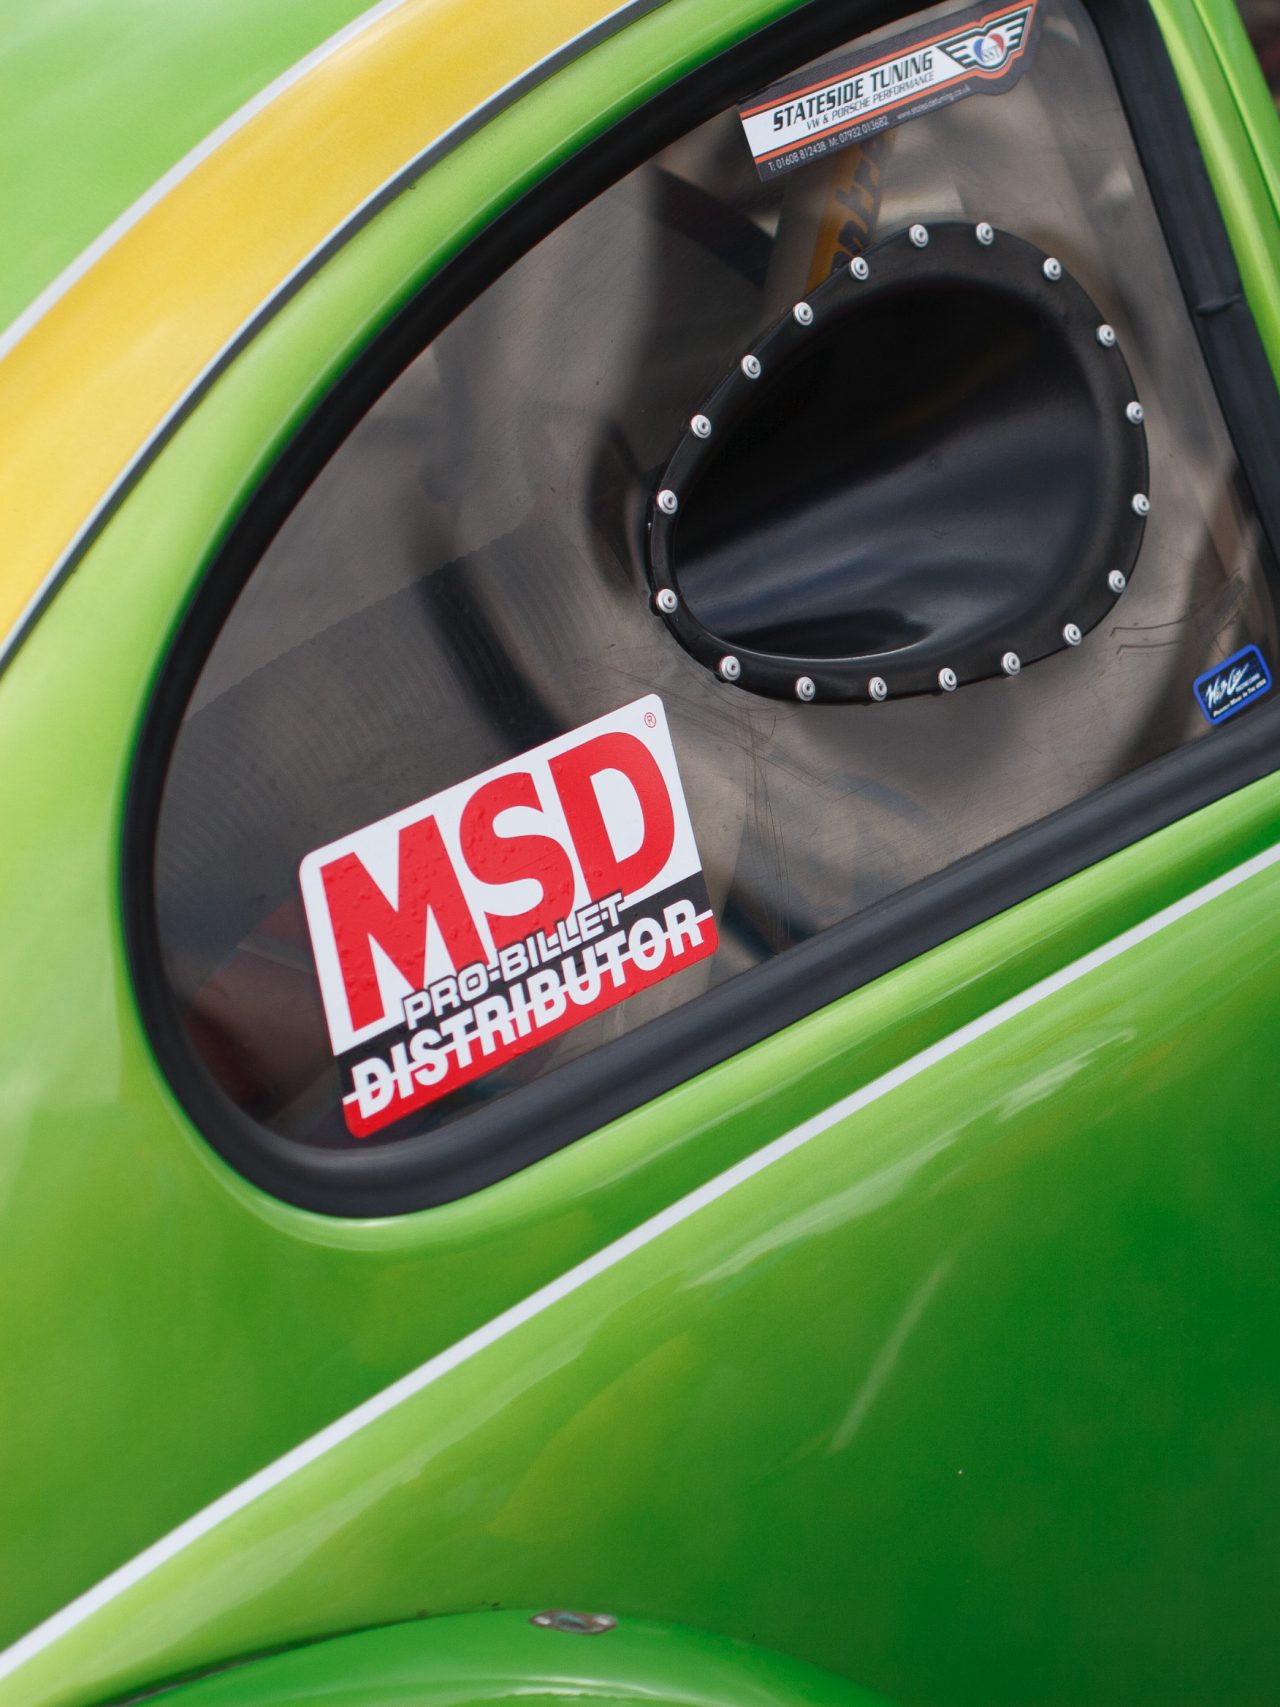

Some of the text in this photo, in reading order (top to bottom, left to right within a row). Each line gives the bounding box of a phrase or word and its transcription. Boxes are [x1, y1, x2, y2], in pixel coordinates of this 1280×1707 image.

[773, 50, 933, 131] STATESIDE TUNING
[806, 70, 935, 131] VW & PORSCHE PERFORMANCE
[776, 152, 800, 170] 01608
[799, 141, 827, 160] 812438
[320, 731, 675, 1034] MSD
[342, 899, 714, 1119] DISTRIBUTOR
[402, 889, 625, 1030] PRO-BILLET
